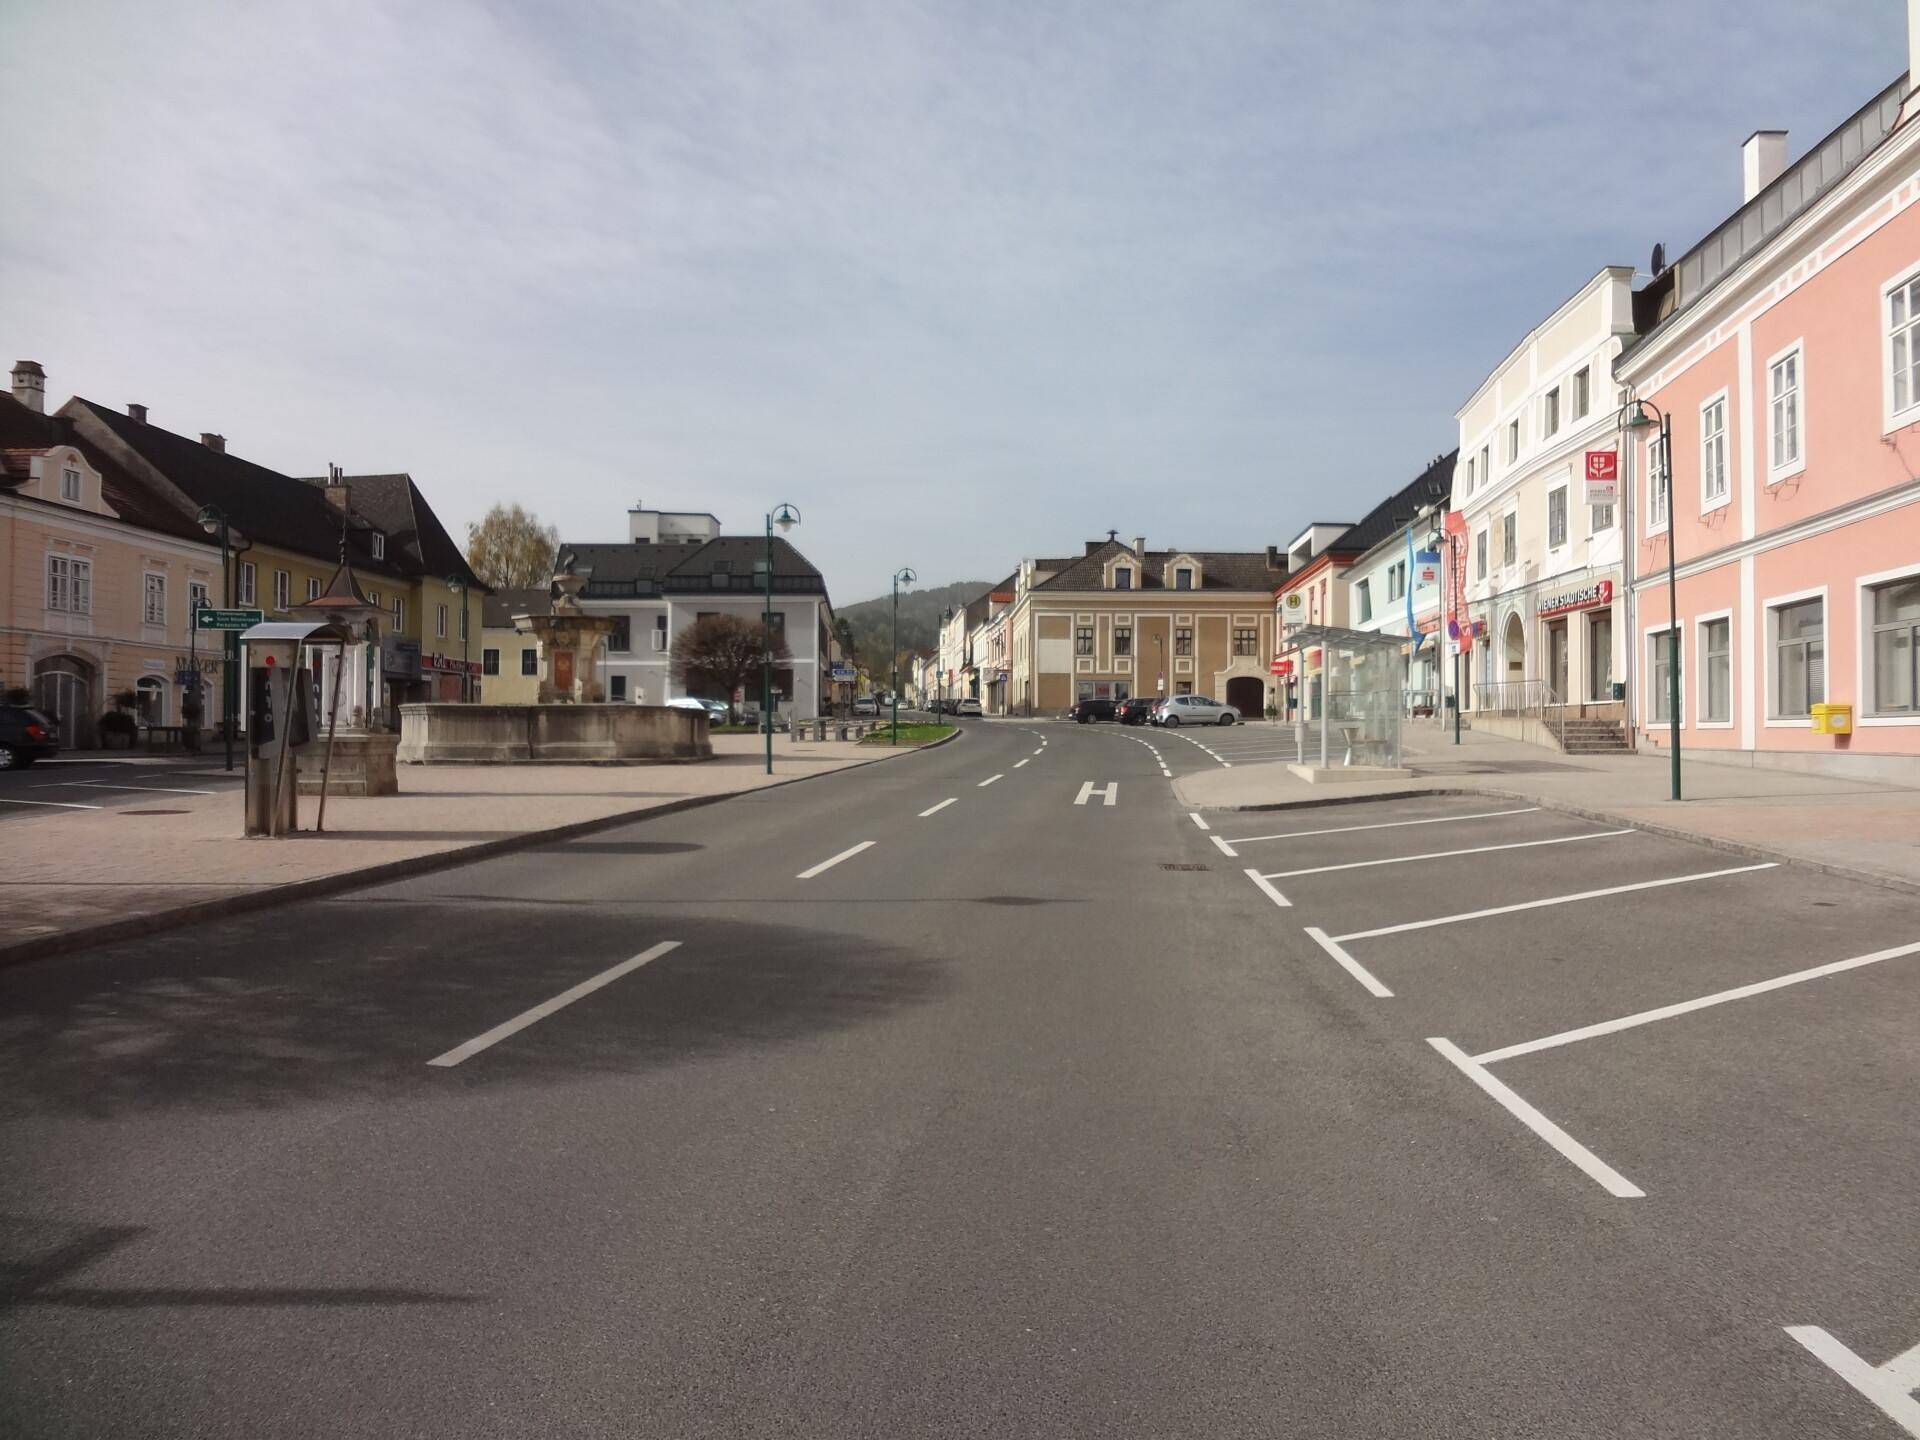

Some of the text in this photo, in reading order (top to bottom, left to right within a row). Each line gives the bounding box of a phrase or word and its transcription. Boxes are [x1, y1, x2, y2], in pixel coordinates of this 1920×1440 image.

[1290, 597, 1298, 606] H
[1536, 595, 1560, 611] WIENER
[1073, 781, 1118, 806] H
